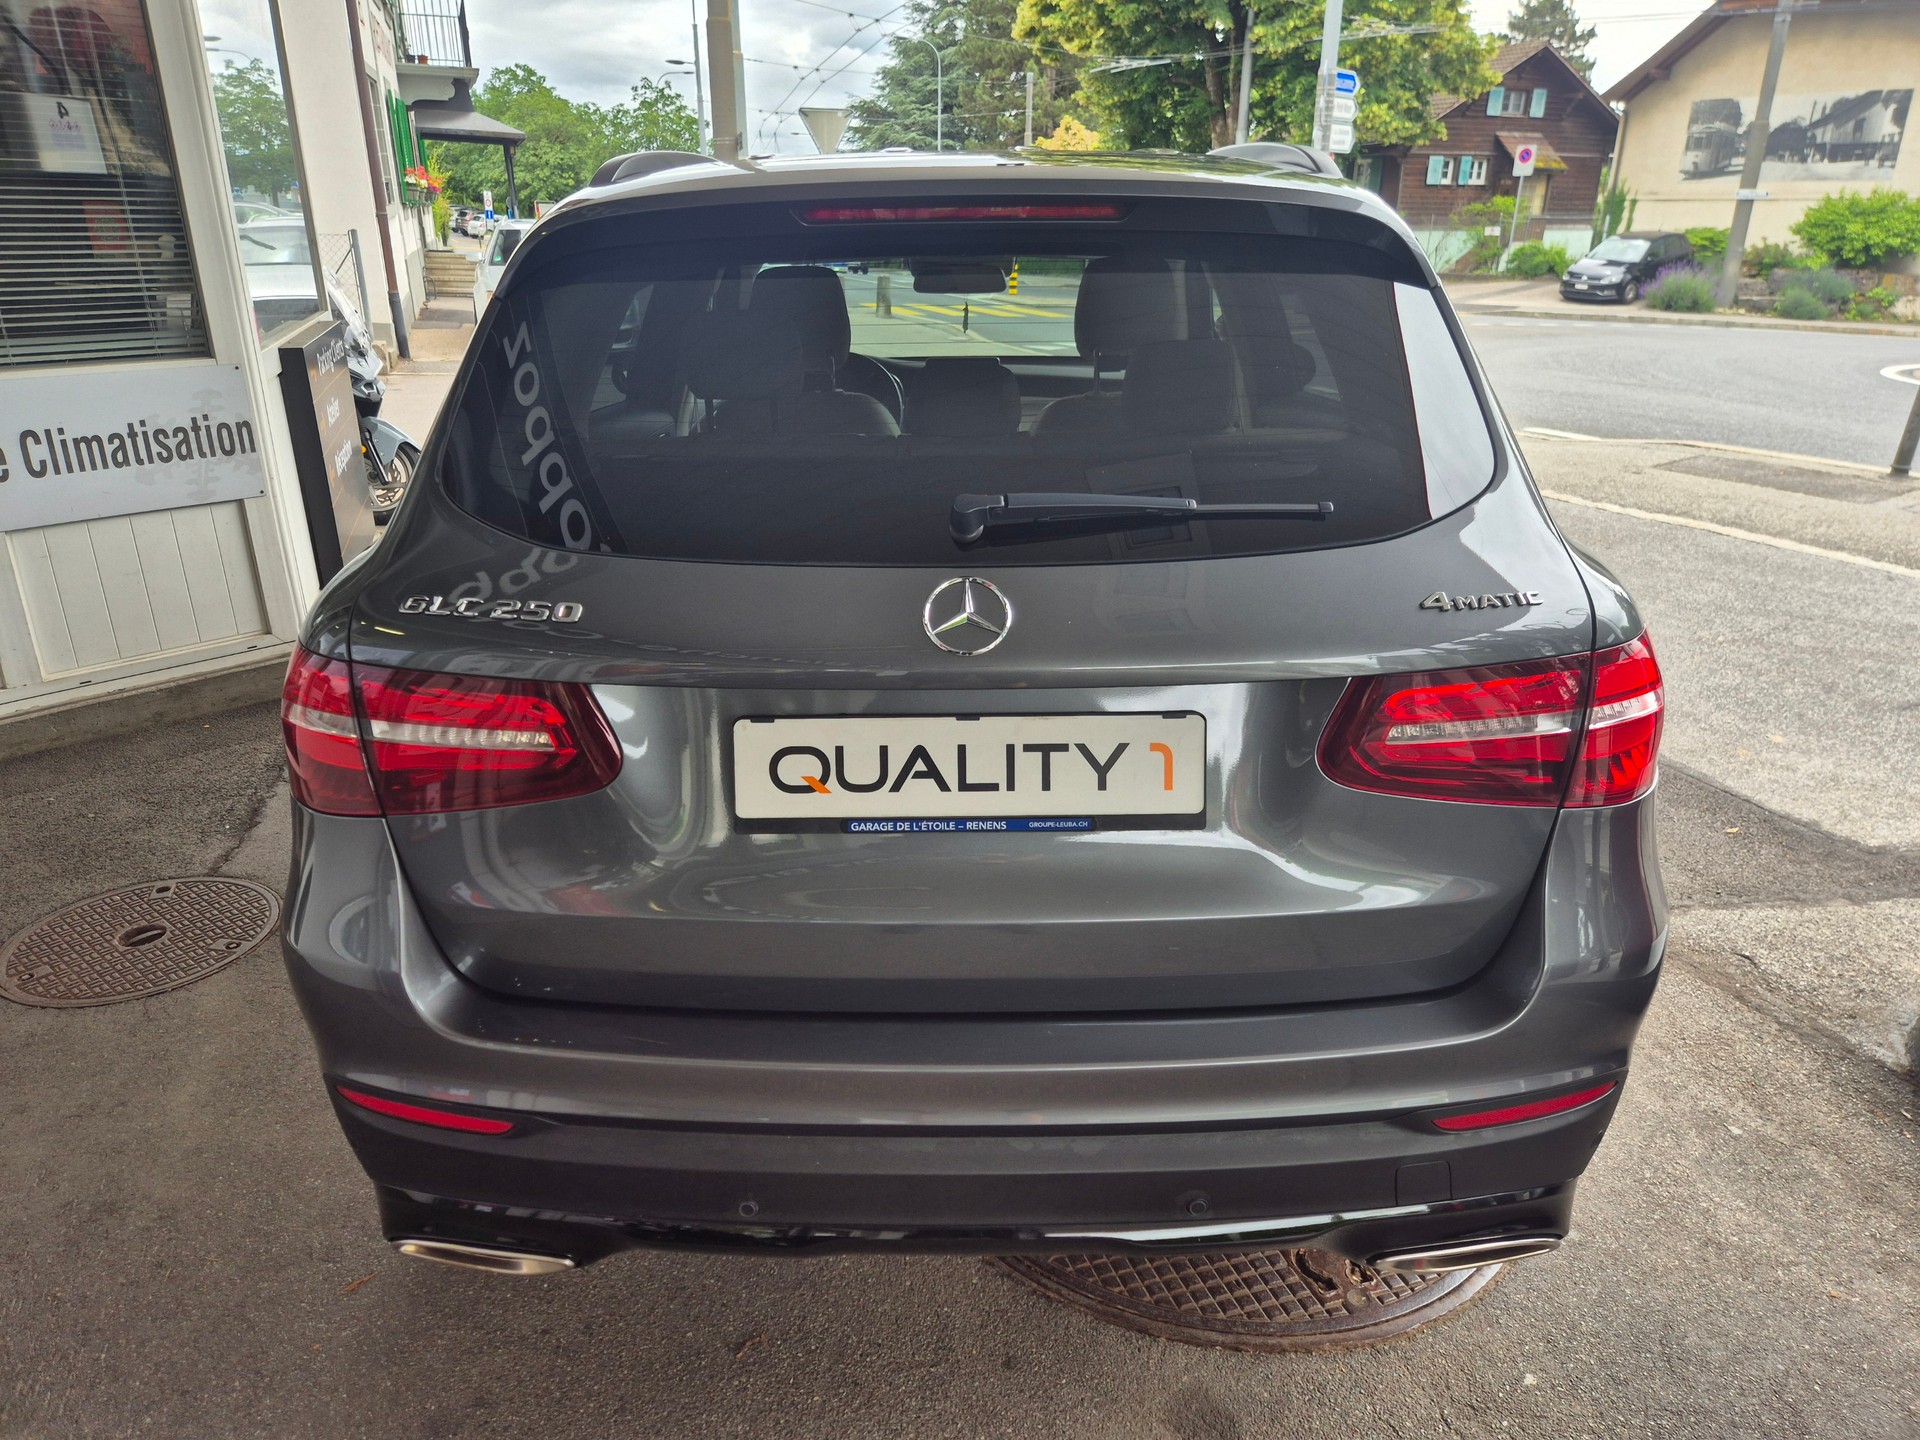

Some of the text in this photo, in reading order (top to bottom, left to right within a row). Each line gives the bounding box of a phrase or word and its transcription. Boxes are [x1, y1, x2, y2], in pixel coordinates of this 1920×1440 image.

[19, 413, 257, 479] Climatisation
[398, 595, 583, 623] GLC 250
[1420, 591, 1544, 611] 4MATIC
[768, 742, 1174, 795] QUALITY 1
[850, 821, 893, 832] GARAGE
[896, 821, 911, 831] DE
[913, 819, 956, 831] L'ÉTOILE
[966, 821, 1007, 831] RENENS
[1028, 820, 1089, 828] GROUPE-LEUBA.CH
